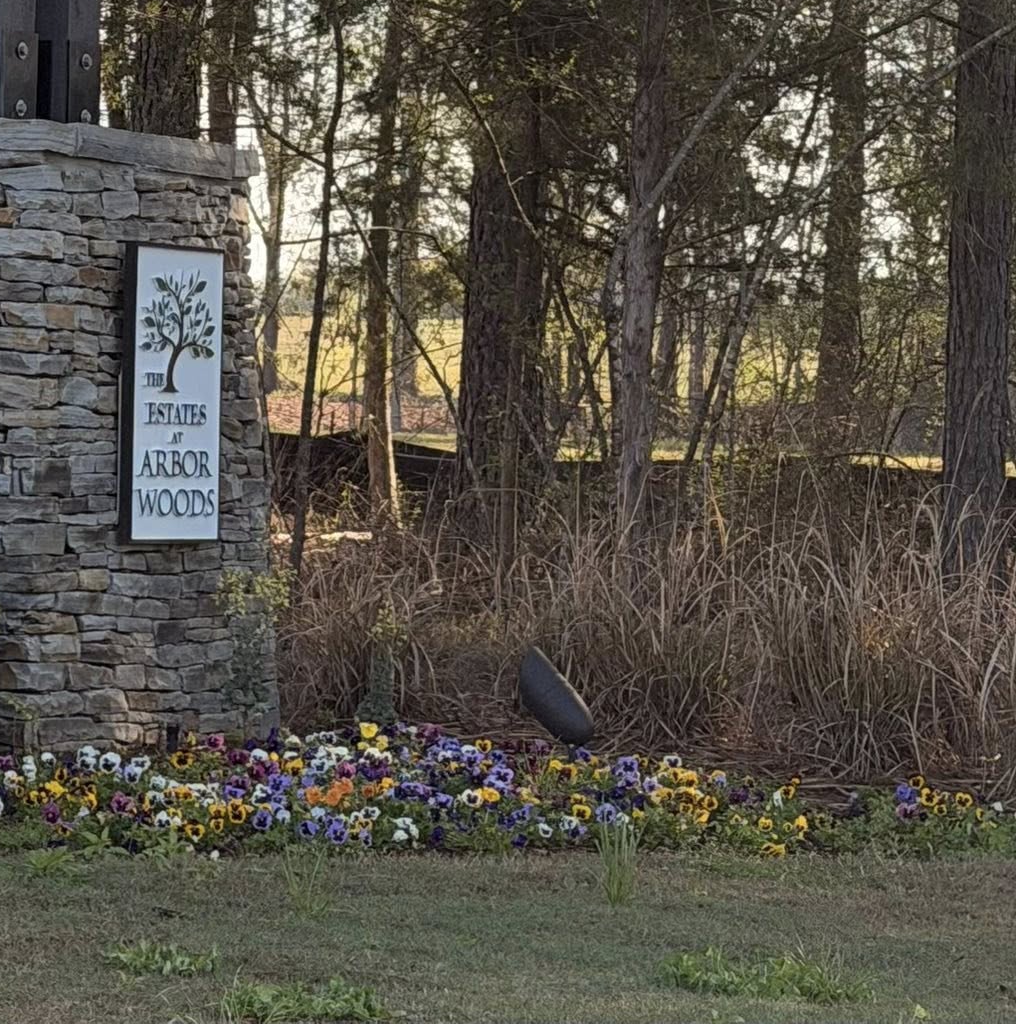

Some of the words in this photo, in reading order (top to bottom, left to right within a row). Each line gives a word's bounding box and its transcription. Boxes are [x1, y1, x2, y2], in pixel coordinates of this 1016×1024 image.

[144, 372, 165, 387] THE
[145, 403, 207, 425] ESTATES
[169, 432, 184, 444] AT
[138, 450, 212, 477] ARBOR
[135, 488, 215, 517] WOODS
